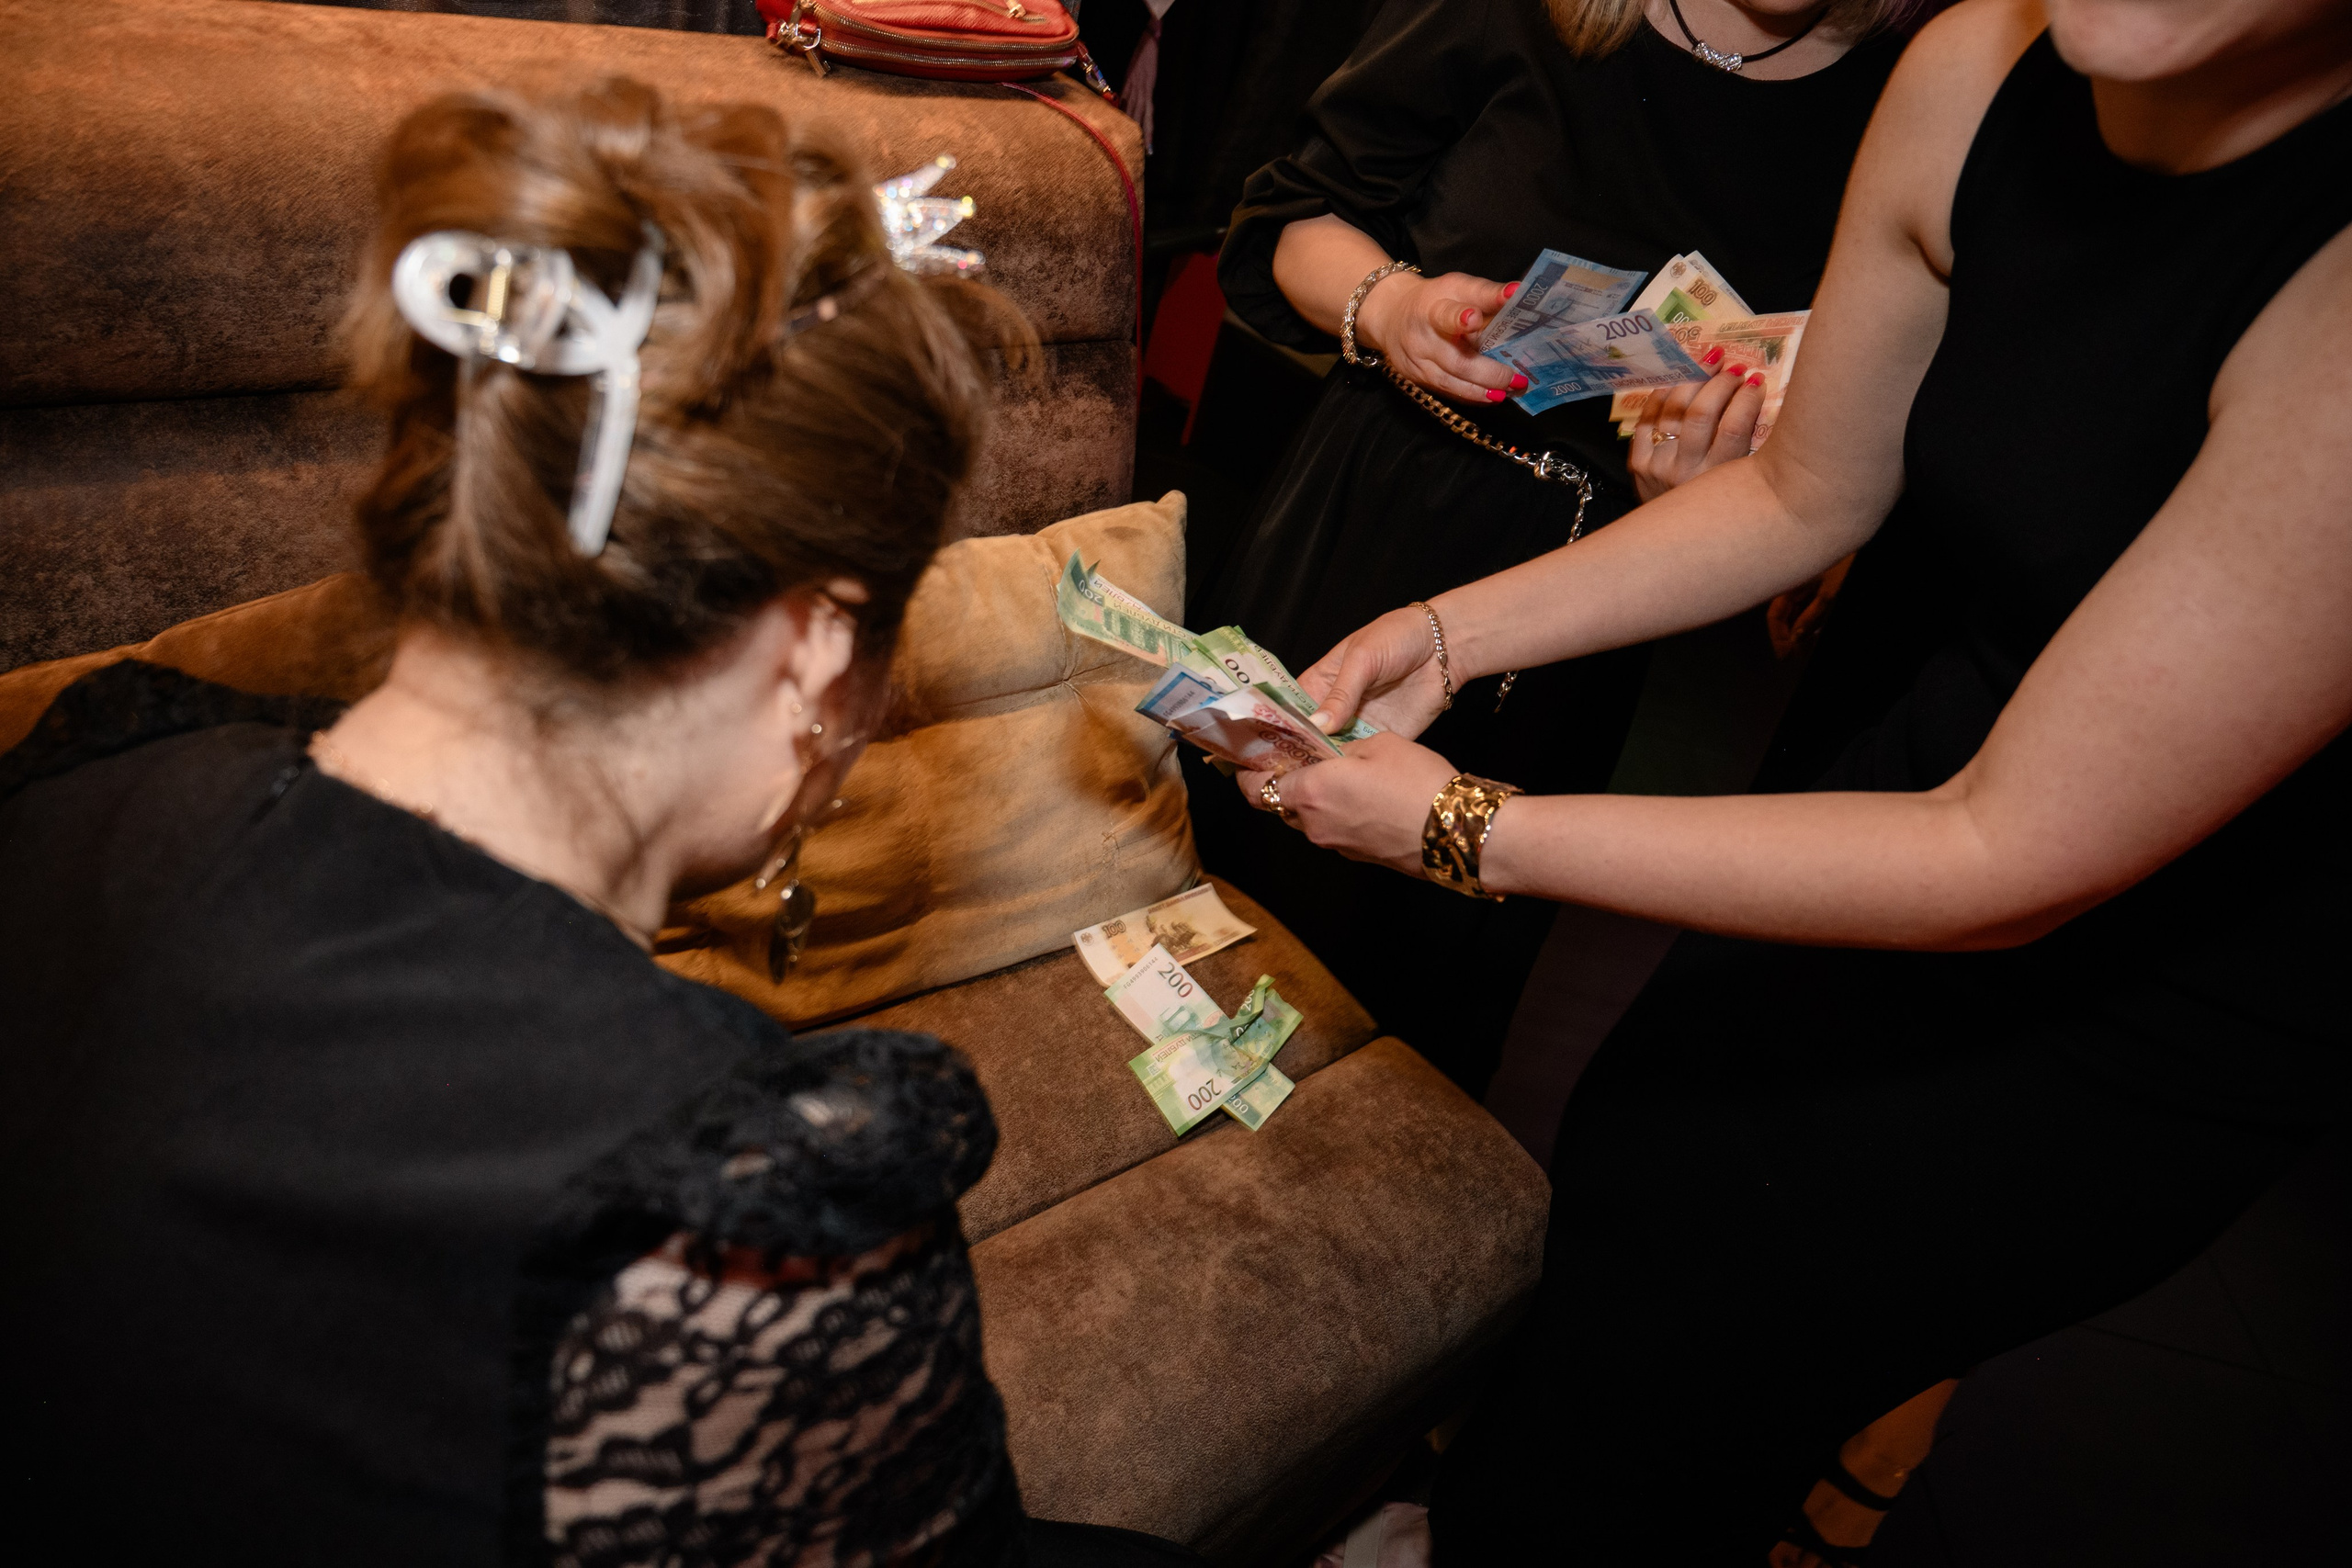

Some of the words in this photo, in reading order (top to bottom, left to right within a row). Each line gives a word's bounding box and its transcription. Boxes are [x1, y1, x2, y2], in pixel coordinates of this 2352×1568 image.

[1523, 282, 1549, 306] 2000
[1685, 277, 1718, 307] 100
[1597, 314, 1653, 341] 2000
[1550, 380, 1582, 396] 2000
[1647, 371, 1687, 385] ДУБЛЕЙ
[1079, 580, 1103, 604] 200
[1114, 602, 1160, 626] ДУБЛЕЙ
[1225, 658, 1250, 684] 00
[1254, 644, 1289, 683] ДУБЛЕЙ
[1101, 919, 1127, 938] 100
[1158, 961, 1193, 998] 200
[1154, 1038, 1186, 1062] ДУБЛЕЙ
[1187, 1077, 1222, 1111] 200
